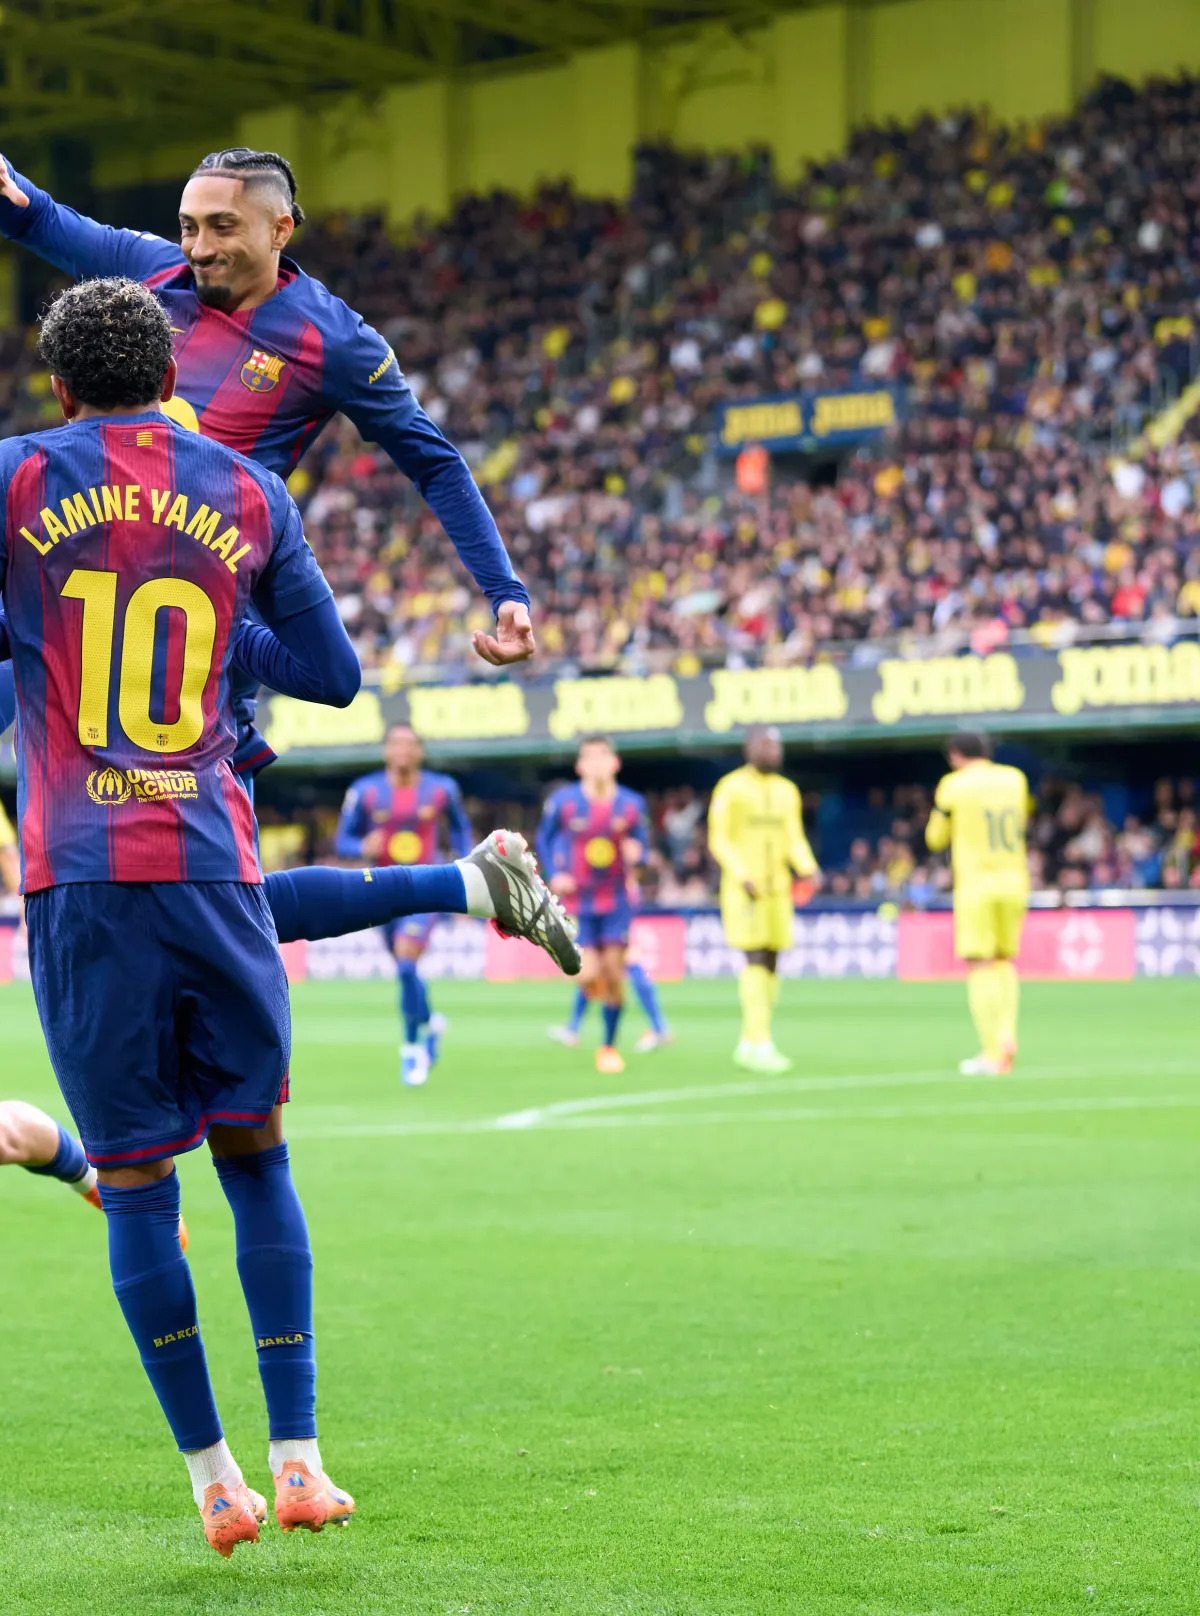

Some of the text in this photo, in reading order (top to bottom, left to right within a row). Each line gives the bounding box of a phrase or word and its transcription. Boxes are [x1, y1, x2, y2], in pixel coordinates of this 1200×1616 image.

[19, 484, 252, 574] LAMINE YAMAL
[59, 568, 218, 754] 10
[125, 769, 196, 784] UNHCR
[133, 777, 199, 797] ACNUR
